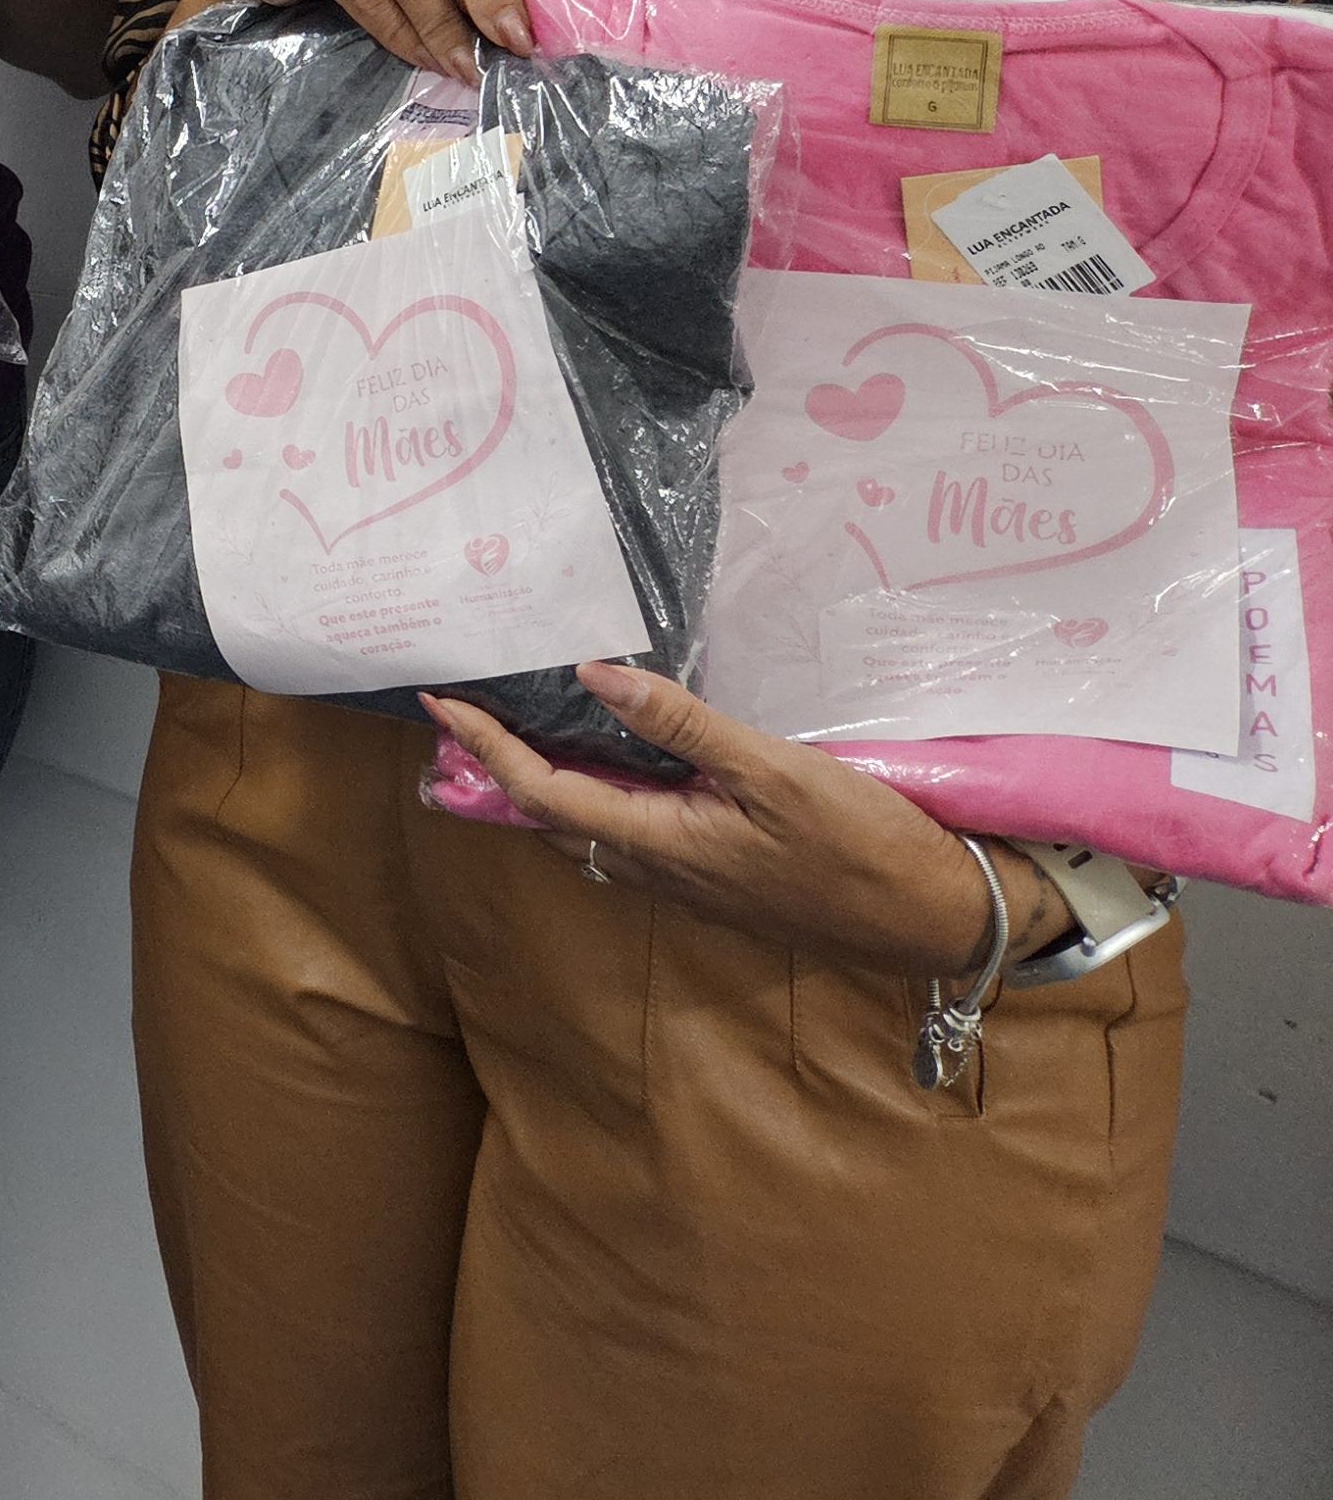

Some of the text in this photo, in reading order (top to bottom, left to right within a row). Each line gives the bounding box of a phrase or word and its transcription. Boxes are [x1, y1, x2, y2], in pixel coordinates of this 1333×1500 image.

[893, 63, 979, 79] LUA ENCANTADA
[927, 101, 937, 112] G
[423, 197, 442, 213] LUA
[966, 201, 1071, 256] LUA ENCANTADA
[357, 356, 448, 398] FELIZ DIA
[393, 387, 430, 413] DAS
[345, 415, 463, 488] Mães
[1002, 463, 1053, 487] DAS
[927, 469, 1076, 549] Mães
[311, 550, 428, 574] Toda mãe merece
[372, 567, 421, 582] carinho
[424, 565, 431, 573] e
[318, 598, 440, 627] Que este presente
[868, 608, 907, 622] Toda
[325, 616, 442, 644] aqueça também o
[359, 638, 416, 656] coração.
[862, 656, 898, 668] Que
[1242, 570, 1278, 773] POEMAS
